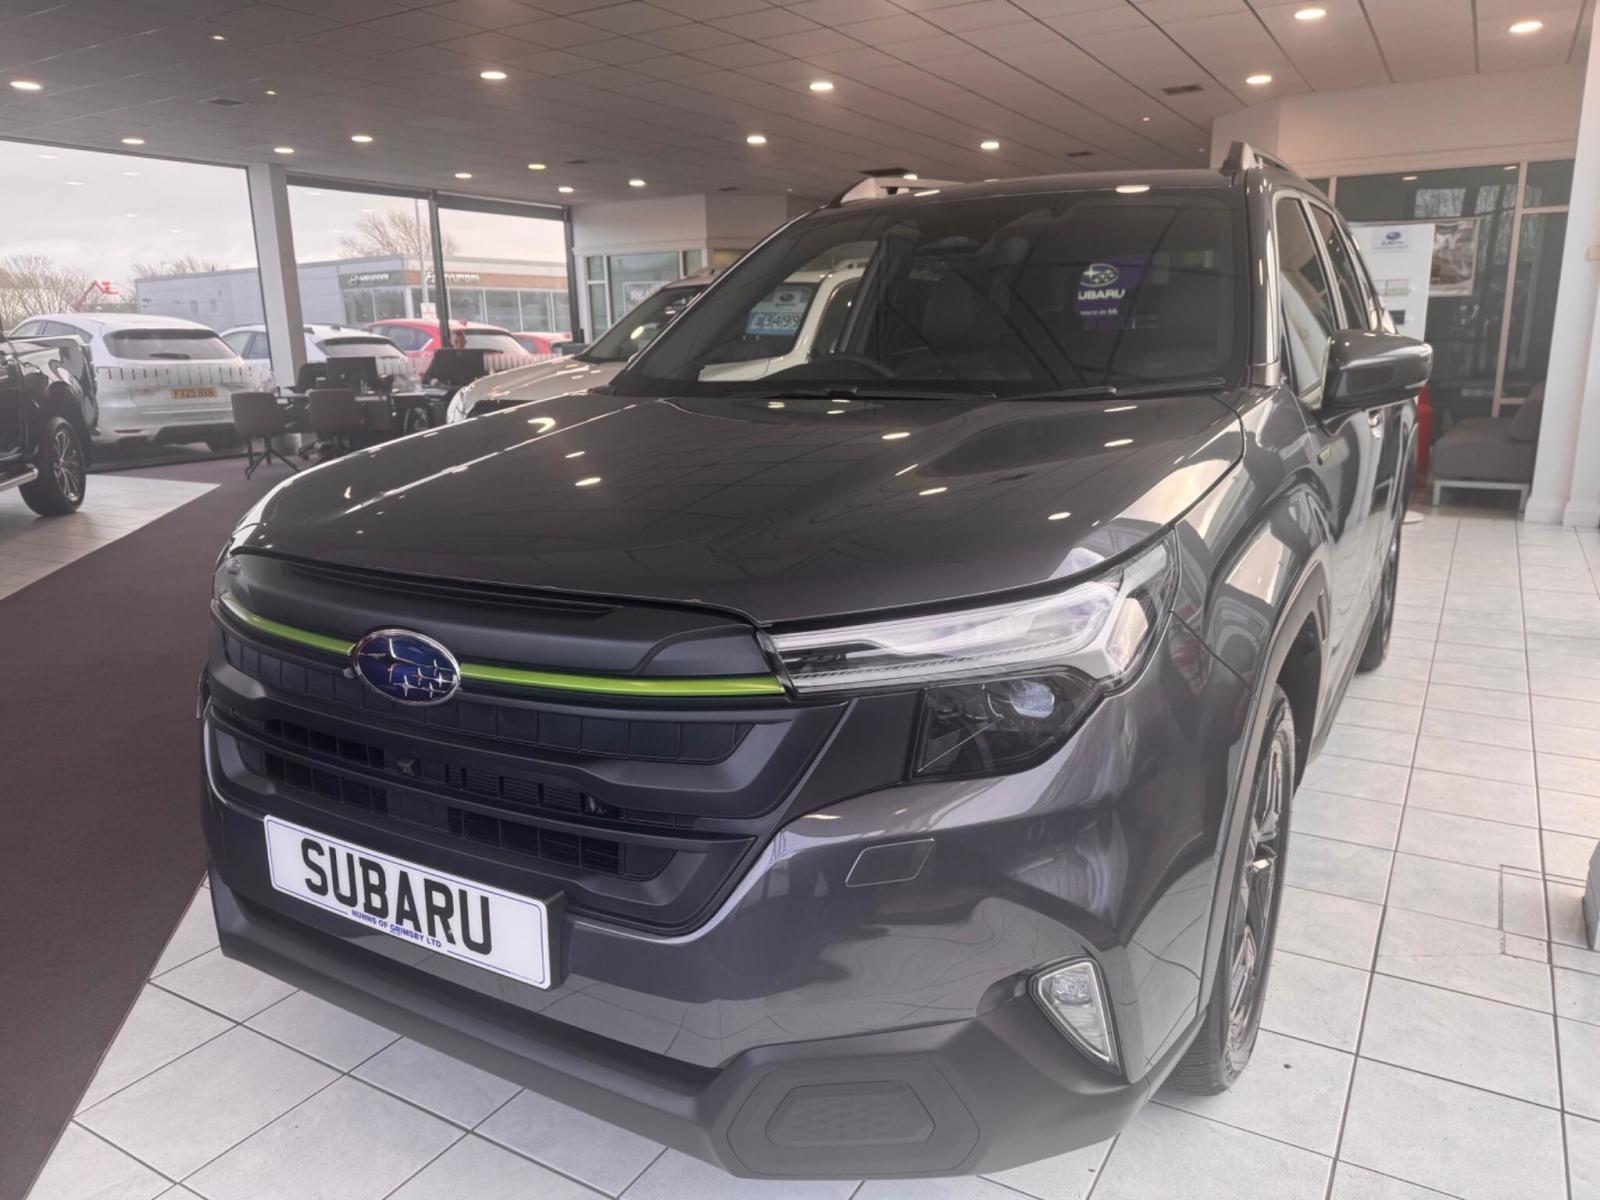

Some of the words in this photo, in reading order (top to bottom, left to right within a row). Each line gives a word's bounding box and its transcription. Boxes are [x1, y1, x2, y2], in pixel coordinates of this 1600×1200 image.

[1078, 289, 1126, 301] UBARU
[301, 838, 492, 956] SUBARU
[378, 918, 388, 929] OF
[390, 923, 424, 941] GRIMSBY
[426, 936, 442, 948] LTD
